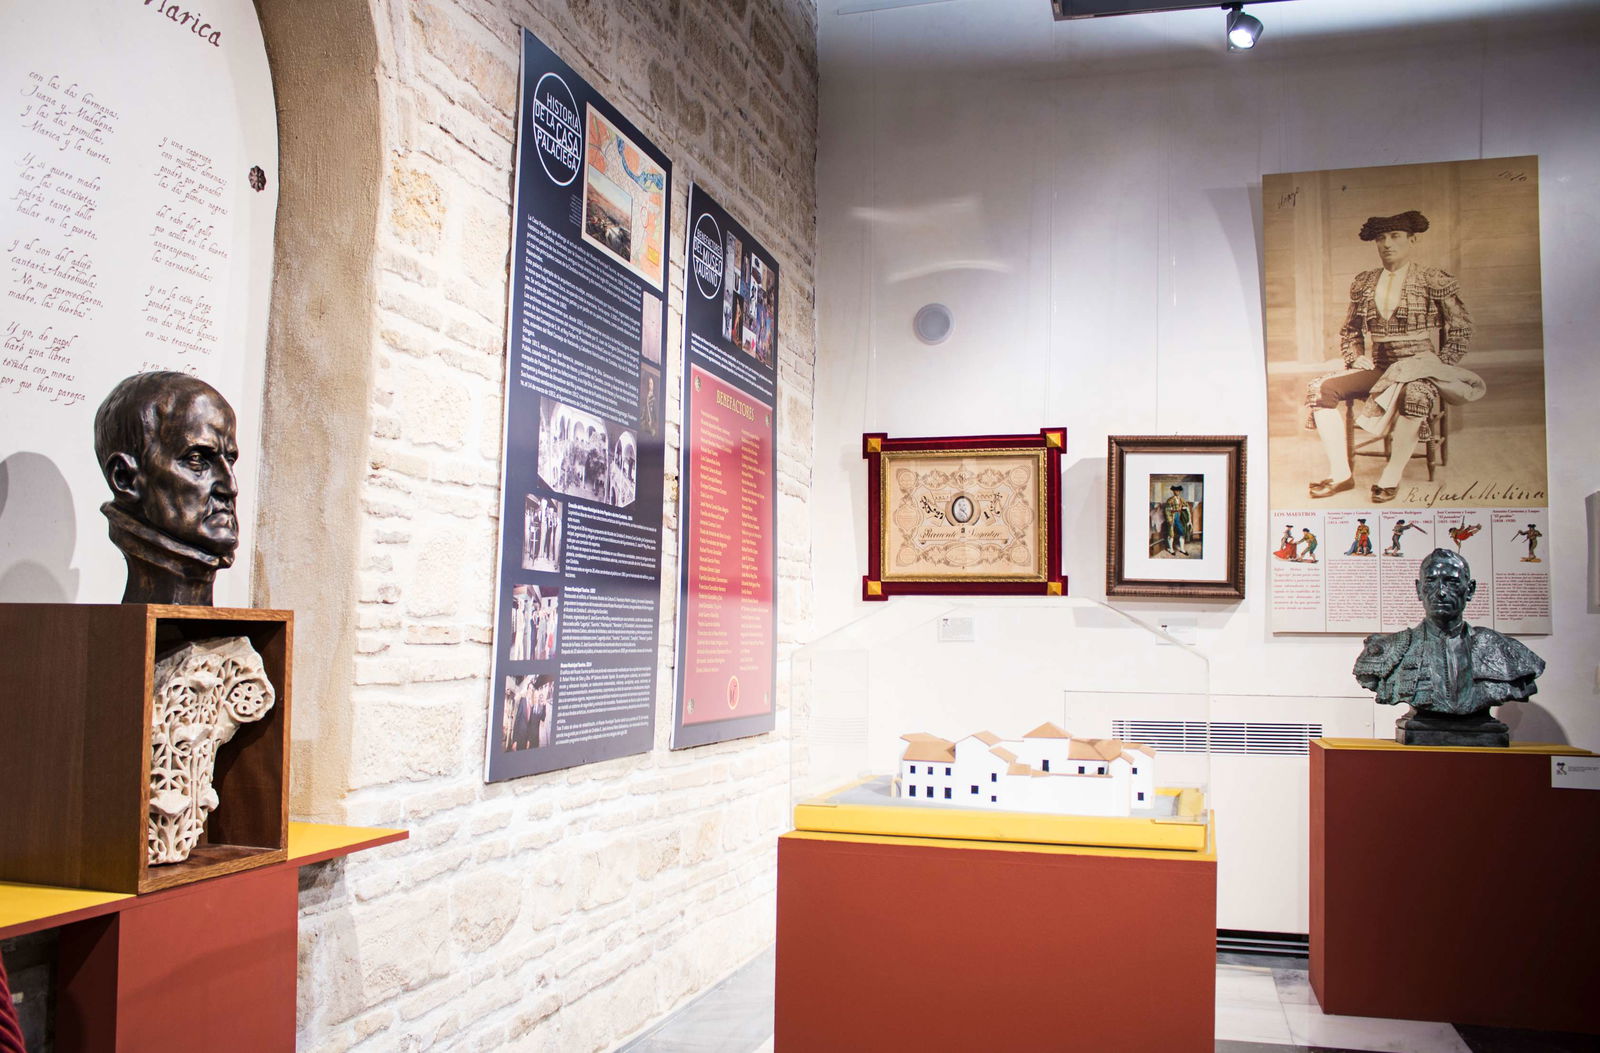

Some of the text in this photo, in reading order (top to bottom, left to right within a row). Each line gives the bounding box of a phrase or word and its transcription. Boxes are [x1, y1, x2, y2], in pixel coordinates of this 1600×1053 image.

[28, 70, 45, 82] con
[47, 75, 60, 90] las
[21, 85, 57, 106] Juana
[20, 105, 32, 117] y
[36, 104, 49, 119] las
[547, 92, 580, 130] HISTORIA
[22, 120, 61, 142] Marica
[59, 139, 71, 151] y
[73, 139, 83, 152] la
[536, 103, 578, 157] DE LA CASA
[158, 136, 168, 148] y
[537, 130, 577, 172] PALACIEGA
[161, 152, 172, 160] con
[19, 167, 36, 183] dar
[39, 174, 52, 188] las
[50, 166, 73, 181] quiere
[77, 176, 101, 191] madre
[16, 199, 41, 218] bailar
[45, 215, 56, 225] en
[59, 216, 70, 229] la
[49, 199, 71, 214] tanto
[24, 239, 39, 250] al
[36, 247, 50, 256] son
[54, 248, 74, 261] del
[703, 247, 722, 274] MUSEO
[695, 259, 717, 287] TAURINO
[35, 280, 48, 289] me
[40, 294, 54, 309] las
[38, 327, 52, 342] de
[29, 348, 44, 357] una
[32, 365, 47, 375] con
[50, 371, 75, 382] moras
[0, 376, 15, 390] por
[13, 381, 32, 394] que
[37, 377, 53, 393] bien
[717, 390, 755, 421] BENEFACTORES
[1404, 481, 1478, 508] Rafael
